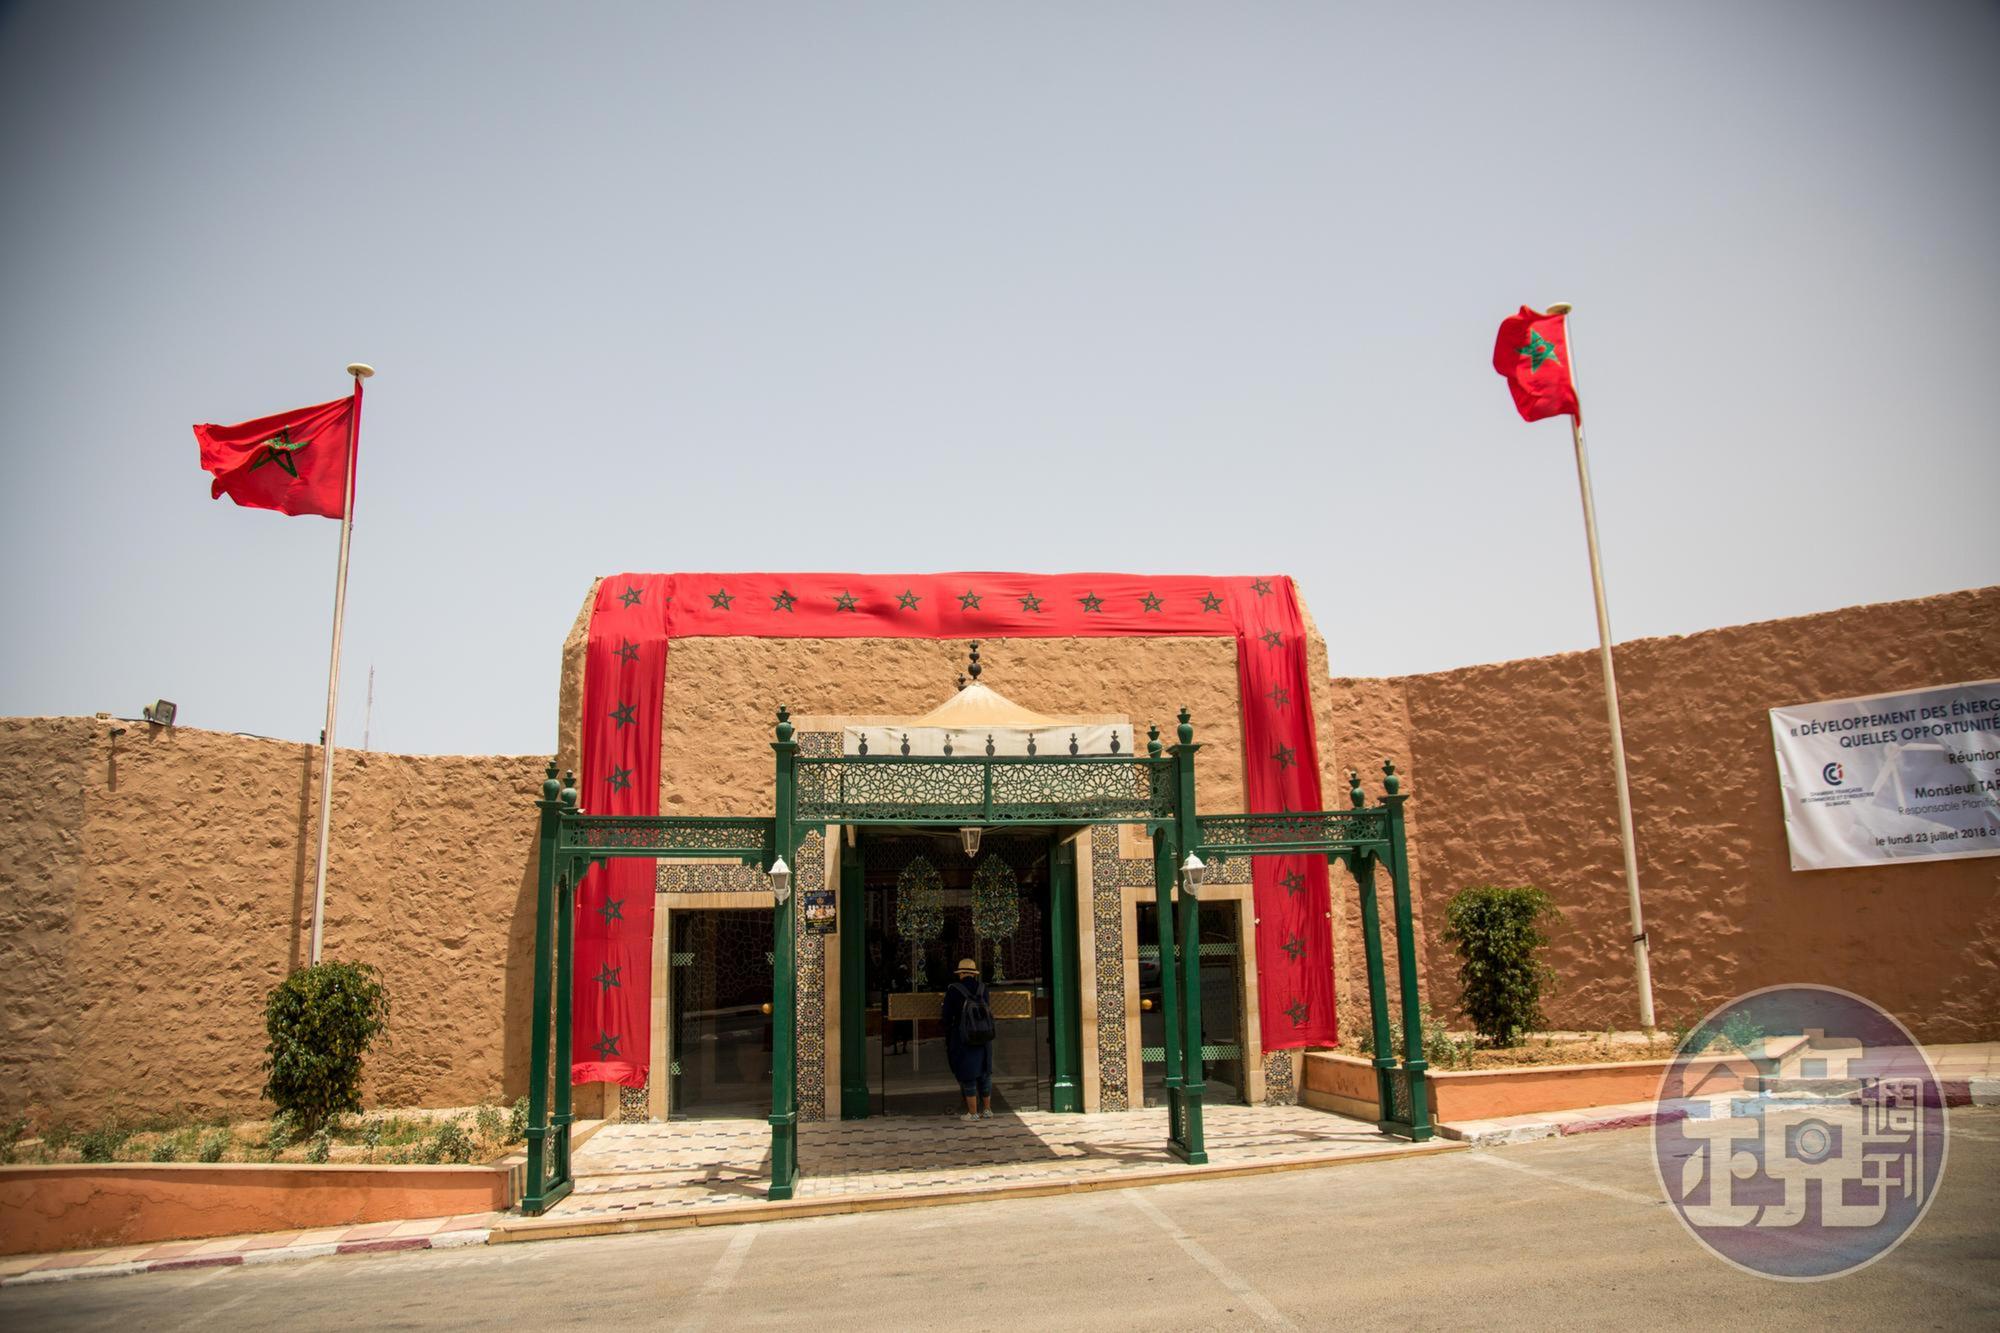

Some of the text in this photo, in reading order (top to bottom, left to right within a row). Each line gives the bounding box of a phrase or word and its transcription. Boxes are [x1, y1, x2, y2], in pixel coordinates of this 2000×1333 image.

[1801, 709, 1917, 736] DÉVELOPPEMENT
[1921, 706, 1948, 719] DES
[1952, 698, 2000, 716] ÉNERG
[1840, 713, 2000, 748] QUELLES OPPORTUNITÉ
[1915, 783, 1976, 799] Monsieur
[1898, 803, 1960, 816] Responsable
[1875, 837, 1886, 846] le
[1888, 834, 1913, 846] lundi
[1915, 833, 1928, 843] 23
[1930, 830, 1959, 843] juillet
[1961, 828, 1986, 839] 2018
[1988, 826, 1997, 836] à
